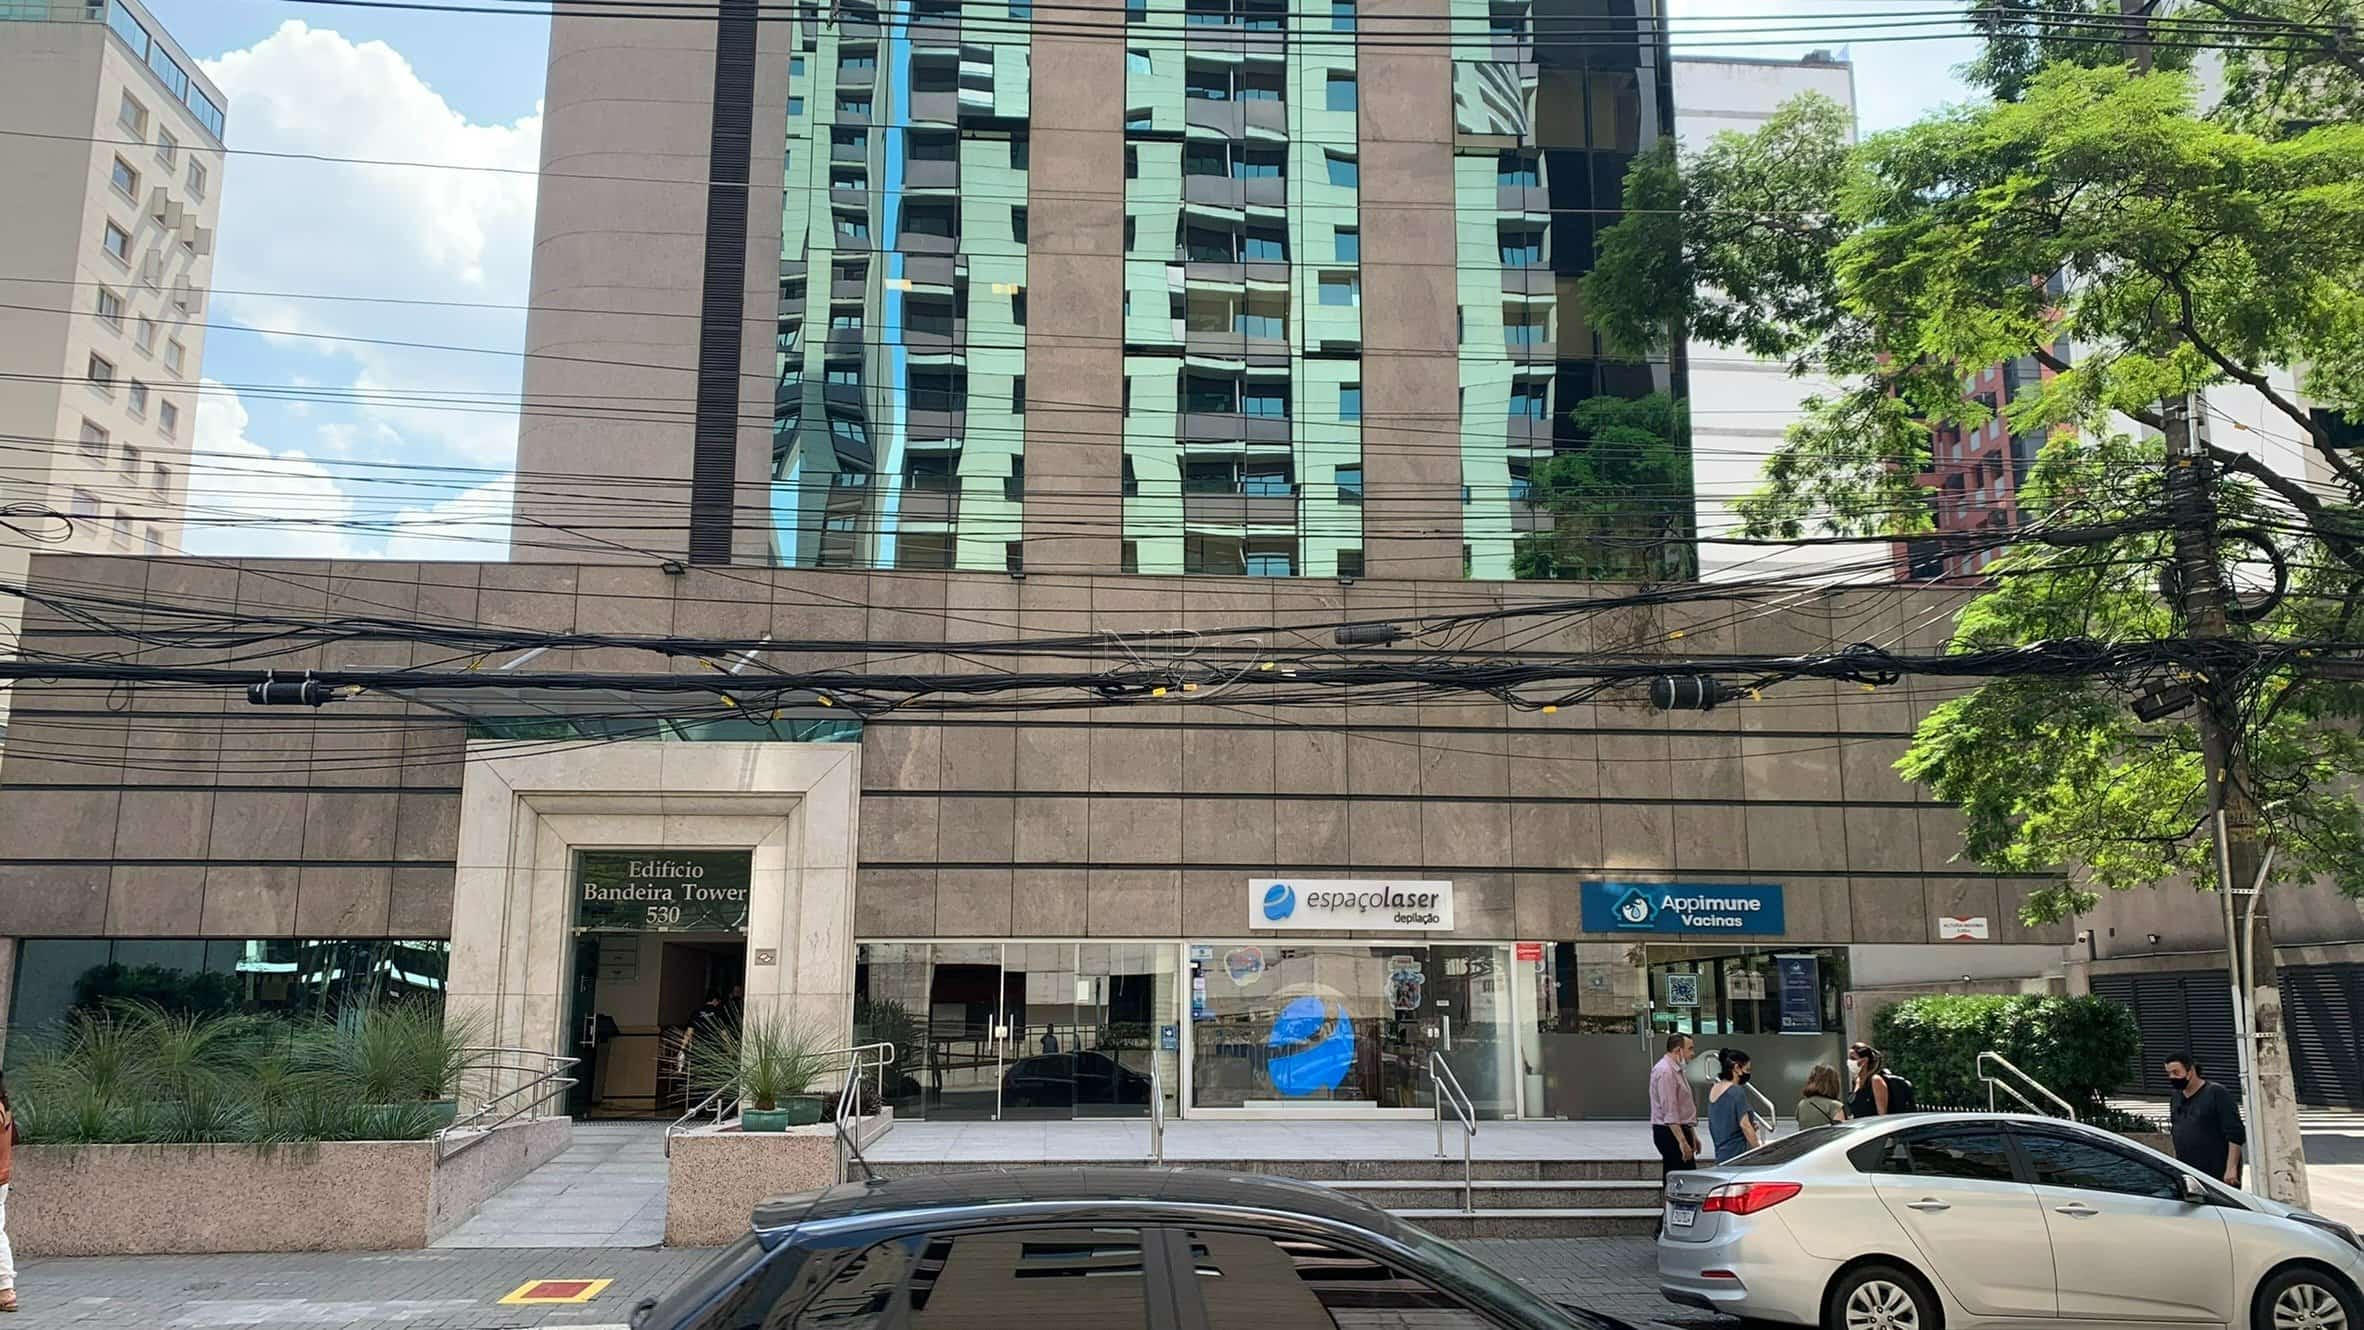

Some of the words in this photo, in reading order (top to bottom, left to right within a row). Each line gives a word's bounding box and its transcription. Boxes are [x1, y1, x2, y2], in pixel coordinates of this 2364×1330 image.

[629, 860, 704, 878] Edifício
[583, 883, 673, 901] Bandeira
[681, 883, 747, 901] Tower
[1307, 886, 1439, 912] espaçolaser
[1660, 895, 1761, 913] Appimune
[645, 906, 681, 924] 530
[1393, 911, 1440, 925] depilação
[1681, 914, 1743, 927] Vacinas
